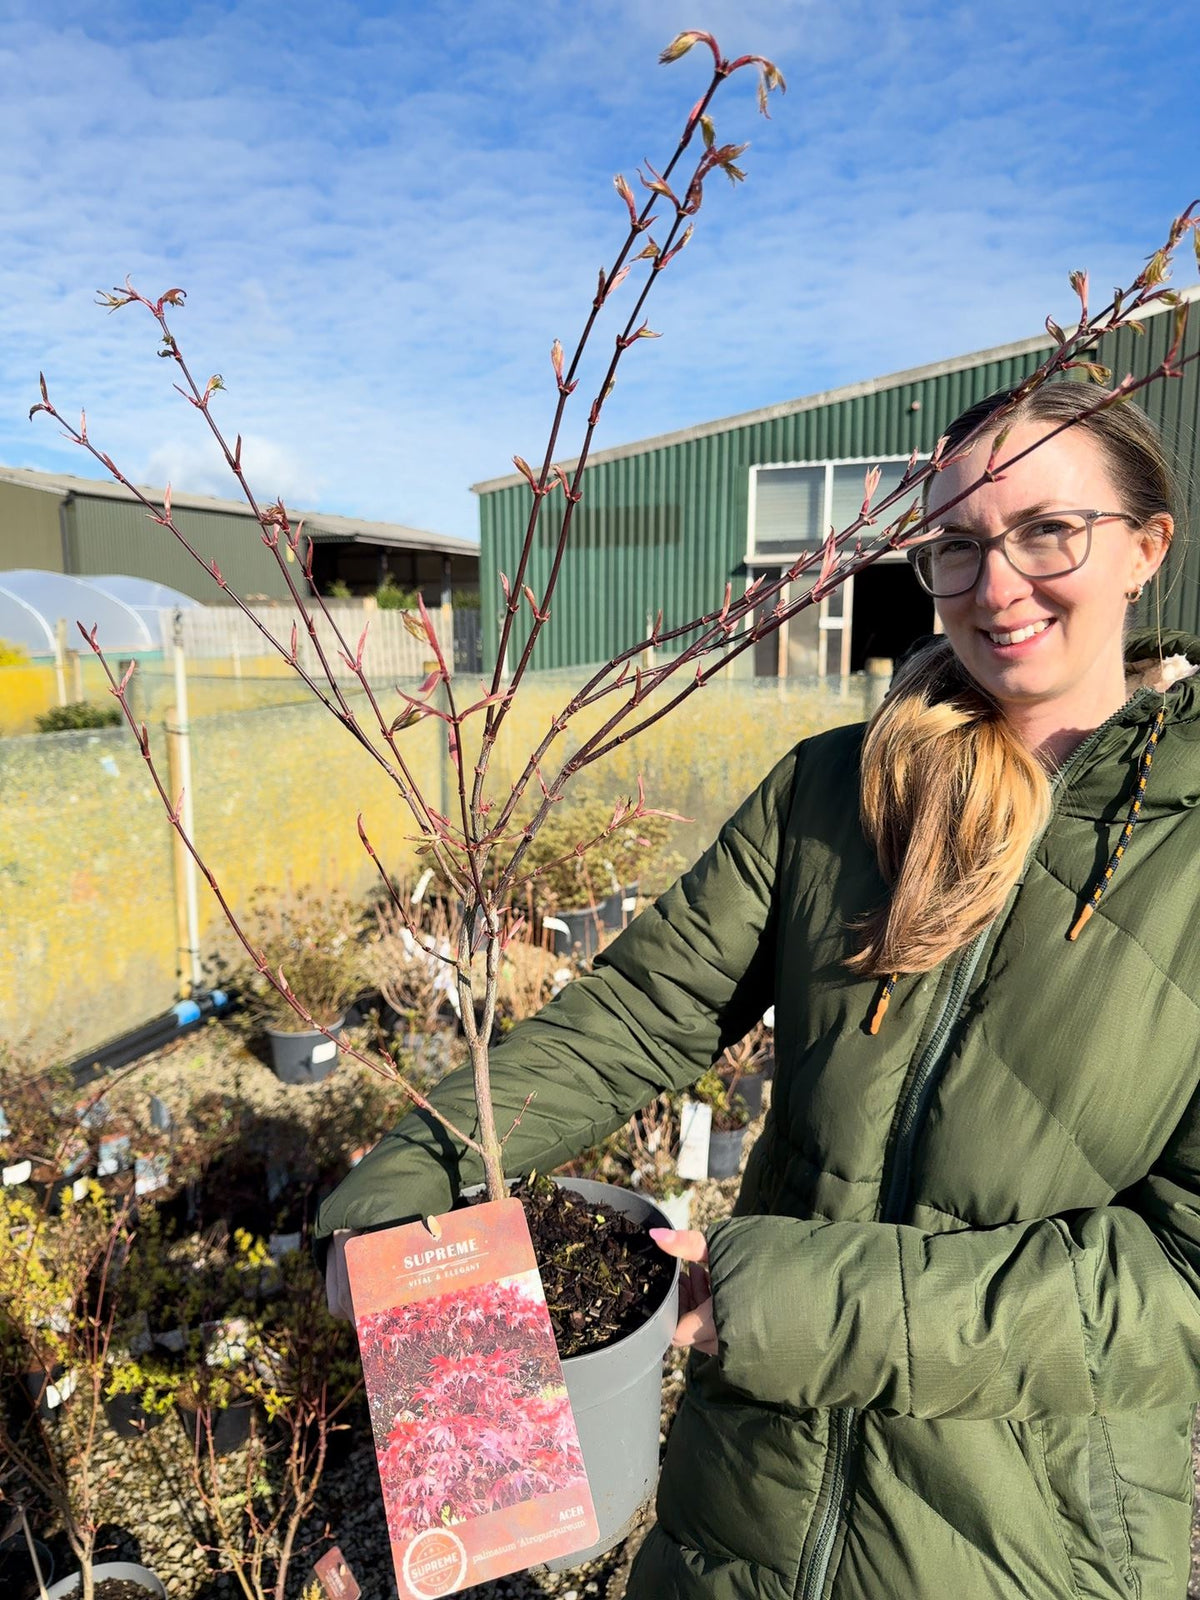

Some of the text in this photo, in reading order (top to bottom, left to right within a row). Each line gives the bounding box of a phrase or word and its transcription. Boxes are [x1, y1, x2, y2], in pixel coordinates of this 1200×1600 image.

[403, 1238, 479, 1270] SUPREME
[408, 1276, 432, 1288] VITAL
[444, 1262, 481, 1278] ELEGANT
[559, 1505, 585, 1522] ACER
[410, 1551, 459, 1579] SUPREME
